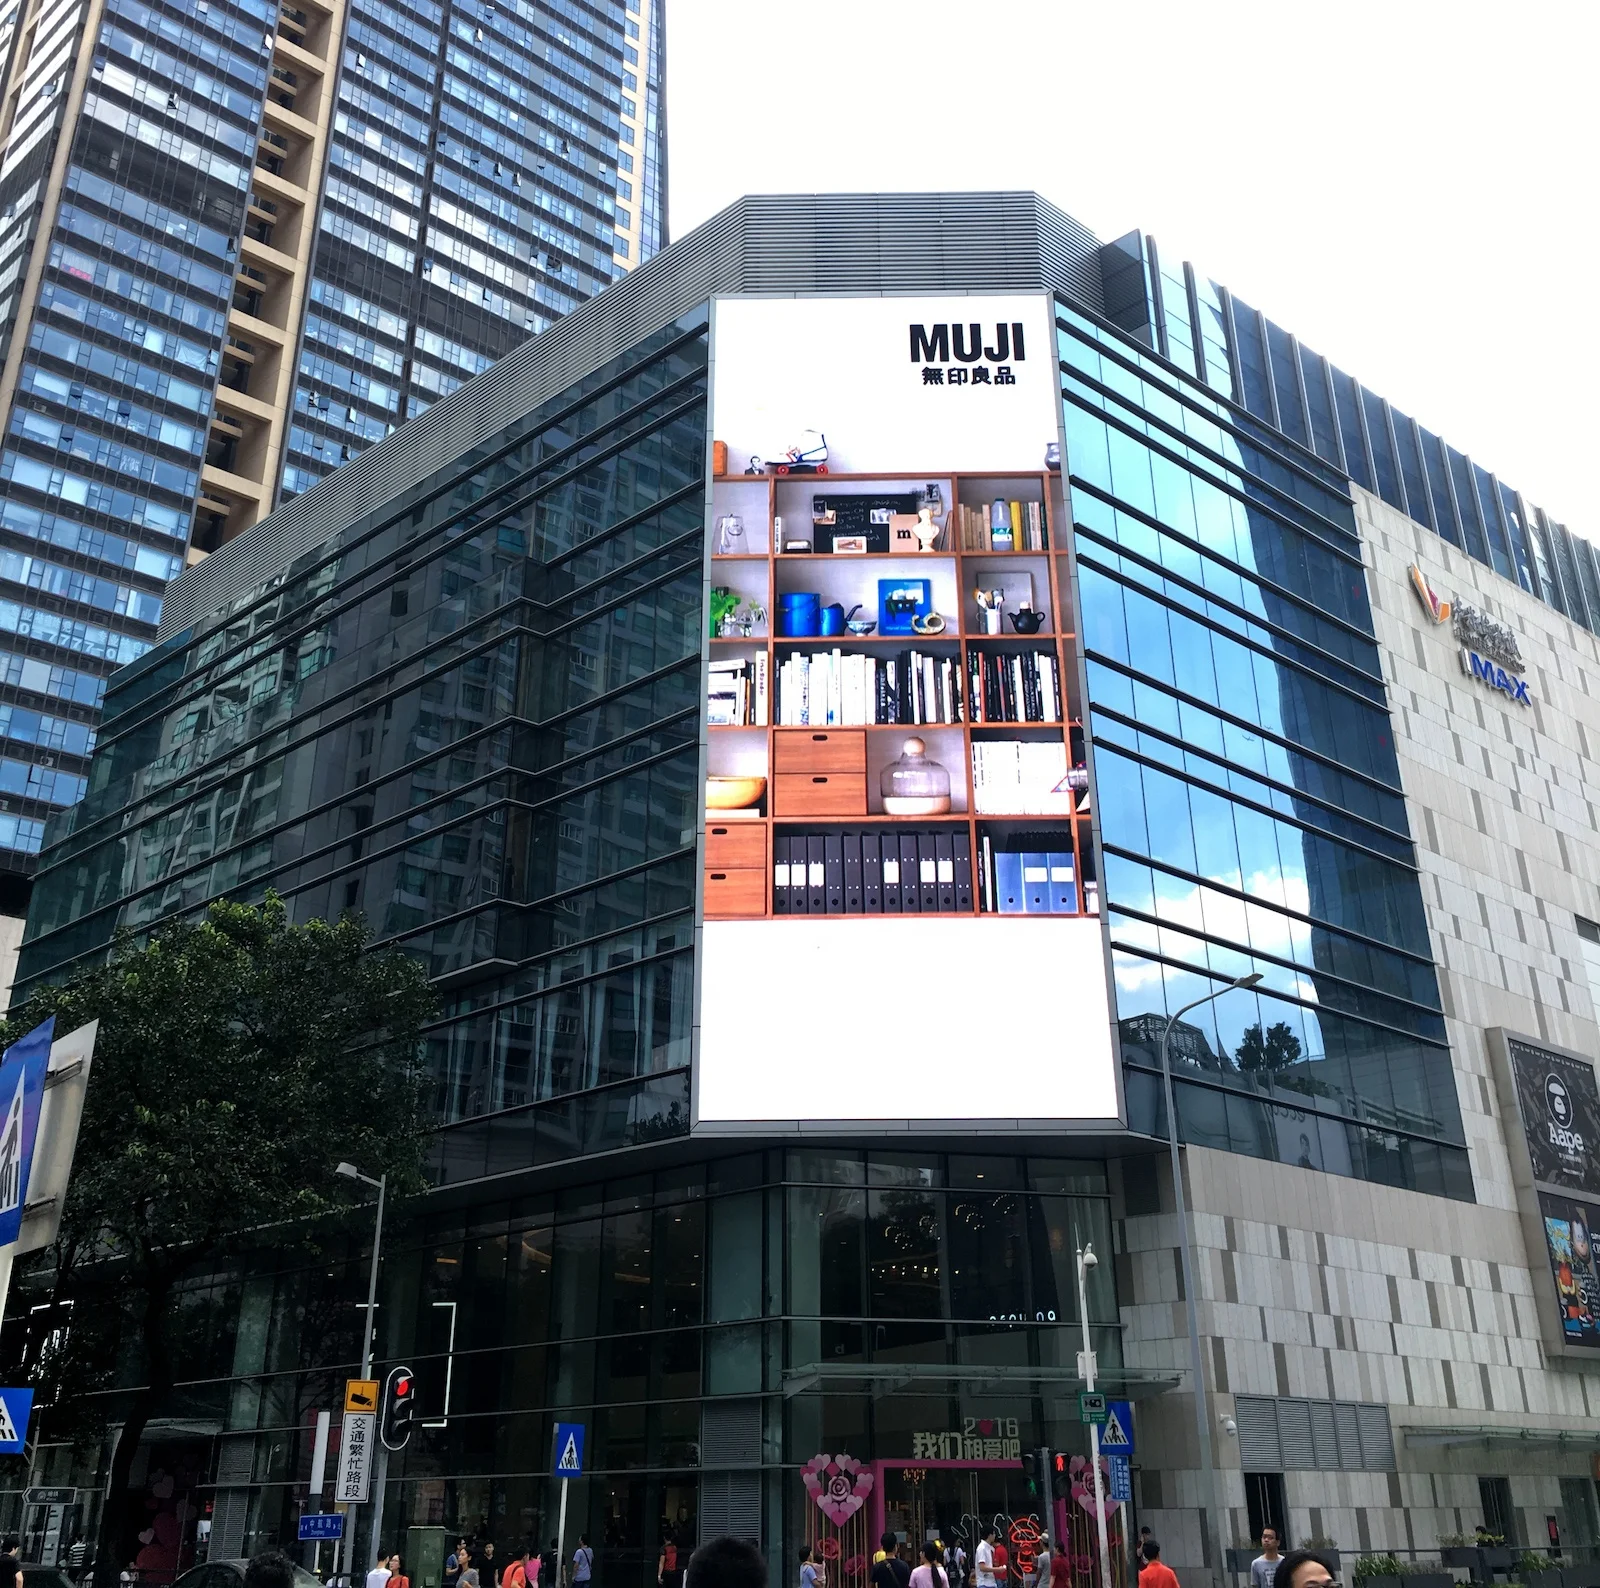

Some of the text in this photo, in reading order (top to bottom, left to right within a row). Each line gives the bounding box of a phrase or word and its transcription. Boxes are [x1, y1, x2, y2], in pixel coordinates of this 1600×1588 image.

[909, 323, 1025, 362] MUJI
[922, 366, 1016, 385] 無印良品
[896, 528, 911, 539] m
[1460, 646, 1531, 707] IMAX
[1548, 1122, 1584, 1154] Aape
[344, 1417, 367, 1498] 交通繁忙路段
[913, 1432, 1021, 1461] 我们相爱吧
